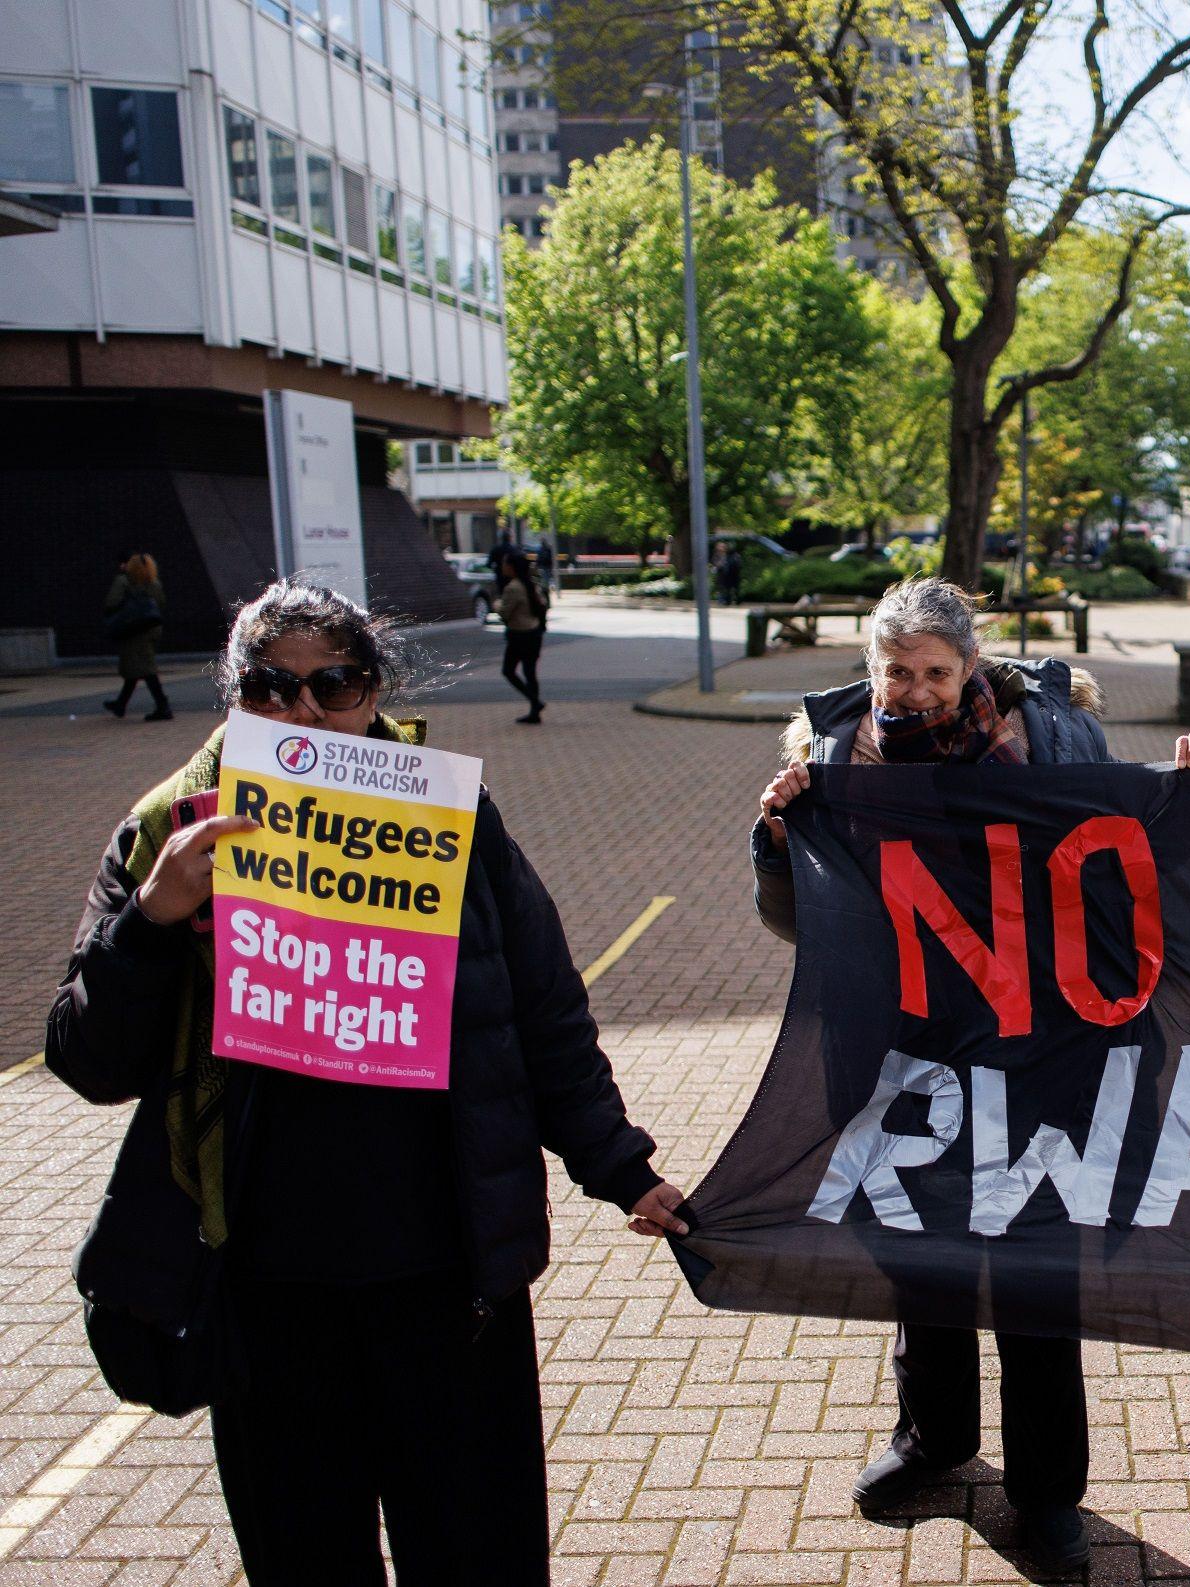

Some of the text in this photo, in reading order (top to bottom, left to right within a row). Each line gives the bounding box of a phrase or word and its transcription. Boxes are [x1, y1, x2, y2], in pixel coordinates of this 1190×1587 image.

[322, 762, 429, 796] TO RACISM
[324, 742, 422, 774] STAND UP
[235, 779, 461, 863] Refugees
[231, 845, 441, 915] welcome
[230, 909, 426, 989] Stop the
[880, 816, 1164, 1037] NO
[228, 966, 419, 1051] far right
[370, 1065, 436, 1080] @AntiRacismDay
